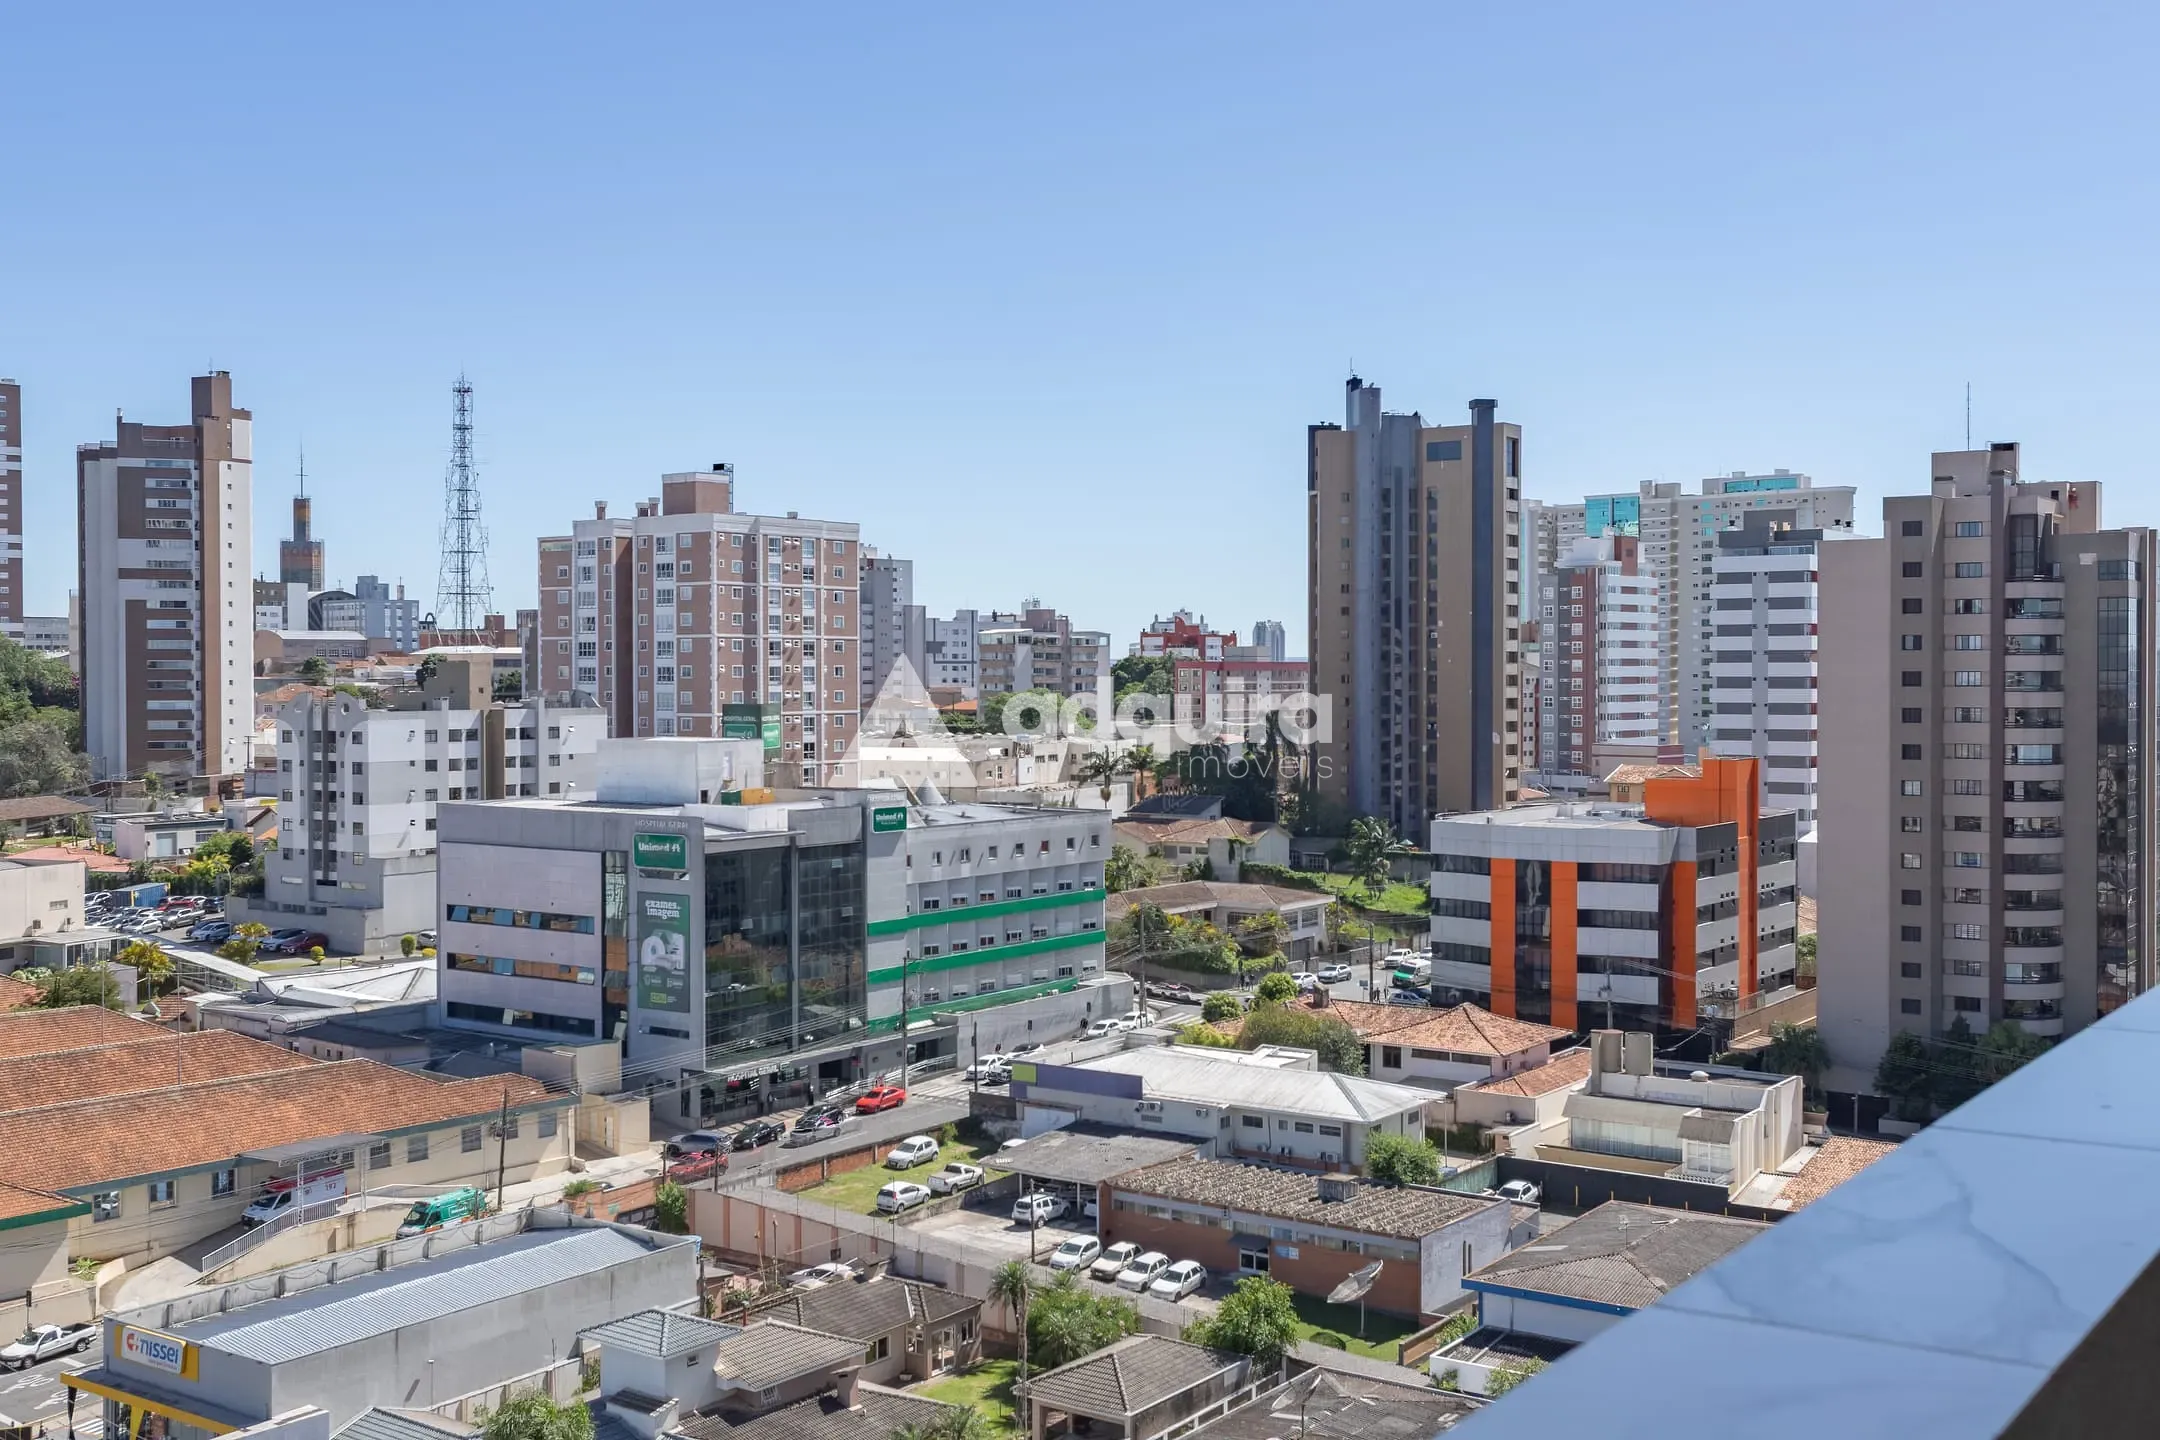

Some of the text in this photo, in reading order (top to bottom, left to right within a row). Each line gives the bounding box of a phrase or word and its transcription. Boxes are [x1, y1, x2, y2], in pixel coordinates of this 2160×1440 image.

[638, 842, 669, 852] Unimed
[645, 900, 677, 909] exames
[647, 908, 680, 919] imagem
[140, 1339, 179, 1364] nissei
